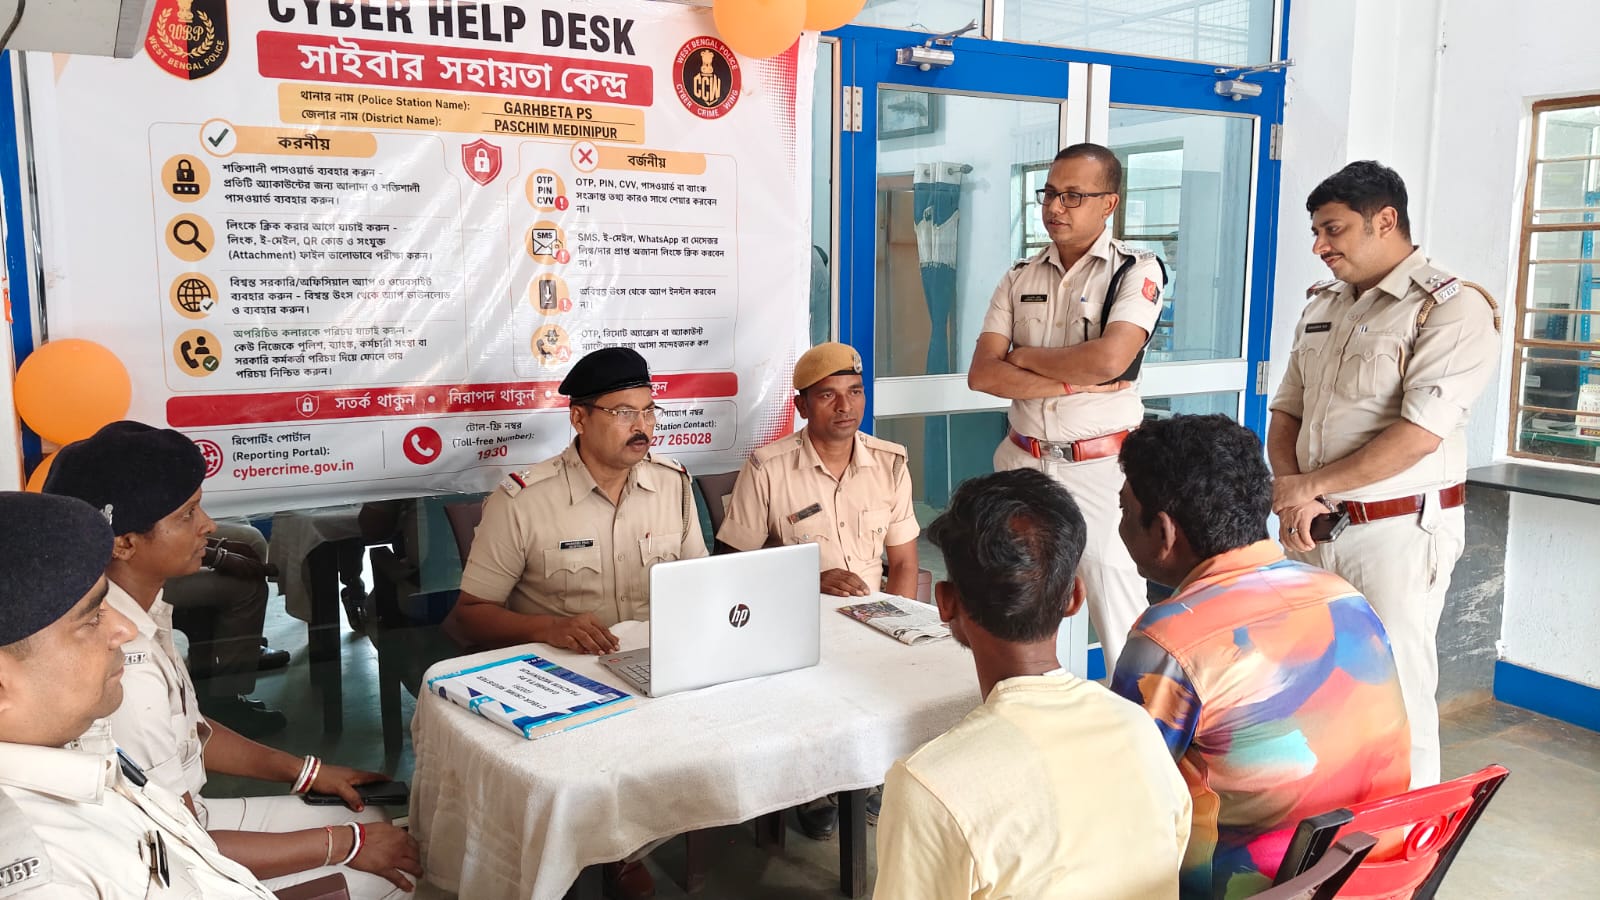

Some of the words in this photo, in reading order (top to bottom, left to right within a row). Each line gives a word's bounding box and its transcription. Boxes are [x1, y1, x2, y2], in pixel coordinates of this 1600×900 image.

[168, 23, 204, 42] WBP
[269, 0, 413, 33] CYBER
[429, 0, 526, 42] HELP
[541, 9, 636, 56] DESK
[148, 35, 168, 59] WEST
[167, 57, 205, 71] BENGAL
[203, 40, 225, 66] POLICE
[677, 44, 692, 64] WEST
[691, 38, 719, 49] BENGAL
[720, 45, 738, 70] POLICE
[298, 37, 425, 82] সাইবার
[438, 55, 553, 92] সহায়তা
[561, 67, 629, 99] কেন্দ্র
[693, 73, 721, 105] CCW
[300, 90, 331, 102] থানার
[335, 92, 354, 103] নাম
[358, 93, 392, 107] (Police
[396, 96, 432, 108] Station
[435, 98, 470, 112] Name):
[504, 101, 572, 119] GARHBETA
[576, 106, 593, 120] PS
[676, 83, 692, 108] CYBER
[697, 107, 720, 117] CRIME
[723, 89, 739, 110] WING
[301, 108, 336, 121] জেলার
[340, 111, 358, 122] নাম
[362, 112, 402, 125] (District
[406, 115, 442, 126] Name):
[494, 119, 549, 135] PASCHIM
[553, 122, 617, 139] MEDINIPUR
[278, 134, 331, 153] করনীয়
[627, 152, 667, 169] বর্জনীয়
[223, 162, 266, 173] শক্তিশালী
[271, 166, 314, 175] পাসওয়ার্ড
[318, 168, 348, 176] ব্যবহার
[352, 168, 375, 176] করুন
[224, 177, 252, 188] প্রতিটি
[257, 180, 310, 190] অ্যাকাউন্টের
[314, 182, 333, 191] জন্য
[381, 183, 420, 192] শক্তিশালী
[536, 176, 553, 184] OTP
[576, 178, 596, 188] OTP,
[600, 179, 617, 189] PIN,
[620, 180, 638, 190] CVV,
[677, 184, 684, 192] বা
[538, 186, 553, 195] PIN
[225, 193, 270, 203] পাসওয়ার্ড
[275, 196, 306, 204] ব্যবহার
[537, 197, 554, 205] CVV
[227, 219, 256, 230] লিংকে
[285, 223, 308, 231] করার
[366, 224, 389, 232] করুন
[304, 237, 317, 246] QR
[347, 237, 353, 245] ও
[578, 233, 600, 242] SMS,
[638, 235, 678, 246] WhatsApp
[228, 250, 295, 261] (Attachment)
[299, 250, 325, 259] ফাইল
[231, 292, 264, 301] ব্যবহার
[268, 292, 292, 300] করুন
[232, 306, 239, 314] ও
[244, 306, 276, 314] ব্যবহার
[233, 328, 278, 338] অপরিচিত
[281, 328, 320, 336] কলারকে
[235, 342, 254, 352] কেউ
[258, 340, 294, 351] নিজেকে
[235, 354, 268, 365] সরকারি
[236, 368, 266, 379] পরিচয়
[270, 366, 300, 377] নিশ্চিত
[335, 391, 371, 411] সতর্ক
[378, 393, 416, 413] থাকুন
[448, 386, 495, 406] নিরাপদ
[500, 388, 536, 407] থাকুন
[651, 381, 669, 397] কুন
[504, 421, 522, 431] নম্বর
[655, 423, 681, 431] Station
[683, 419, 717, 429] Contact):
[276, 431, 311, 444] পোর্টাল
[452, 437, 494, 449] (Toll-free
[496, 433, 535, 444] Number):
[651, 435, 665, 447] 27
[668, 432, 712, 445] 265028
[232, 449, 289, 463] (Reporting
[292, 445, 330, 458] Portal):
[477, 444, 508, 461] 1930
[233, 459, 354, 480] cybercrime.gov.in
[730, 604, 750, 629] hp
